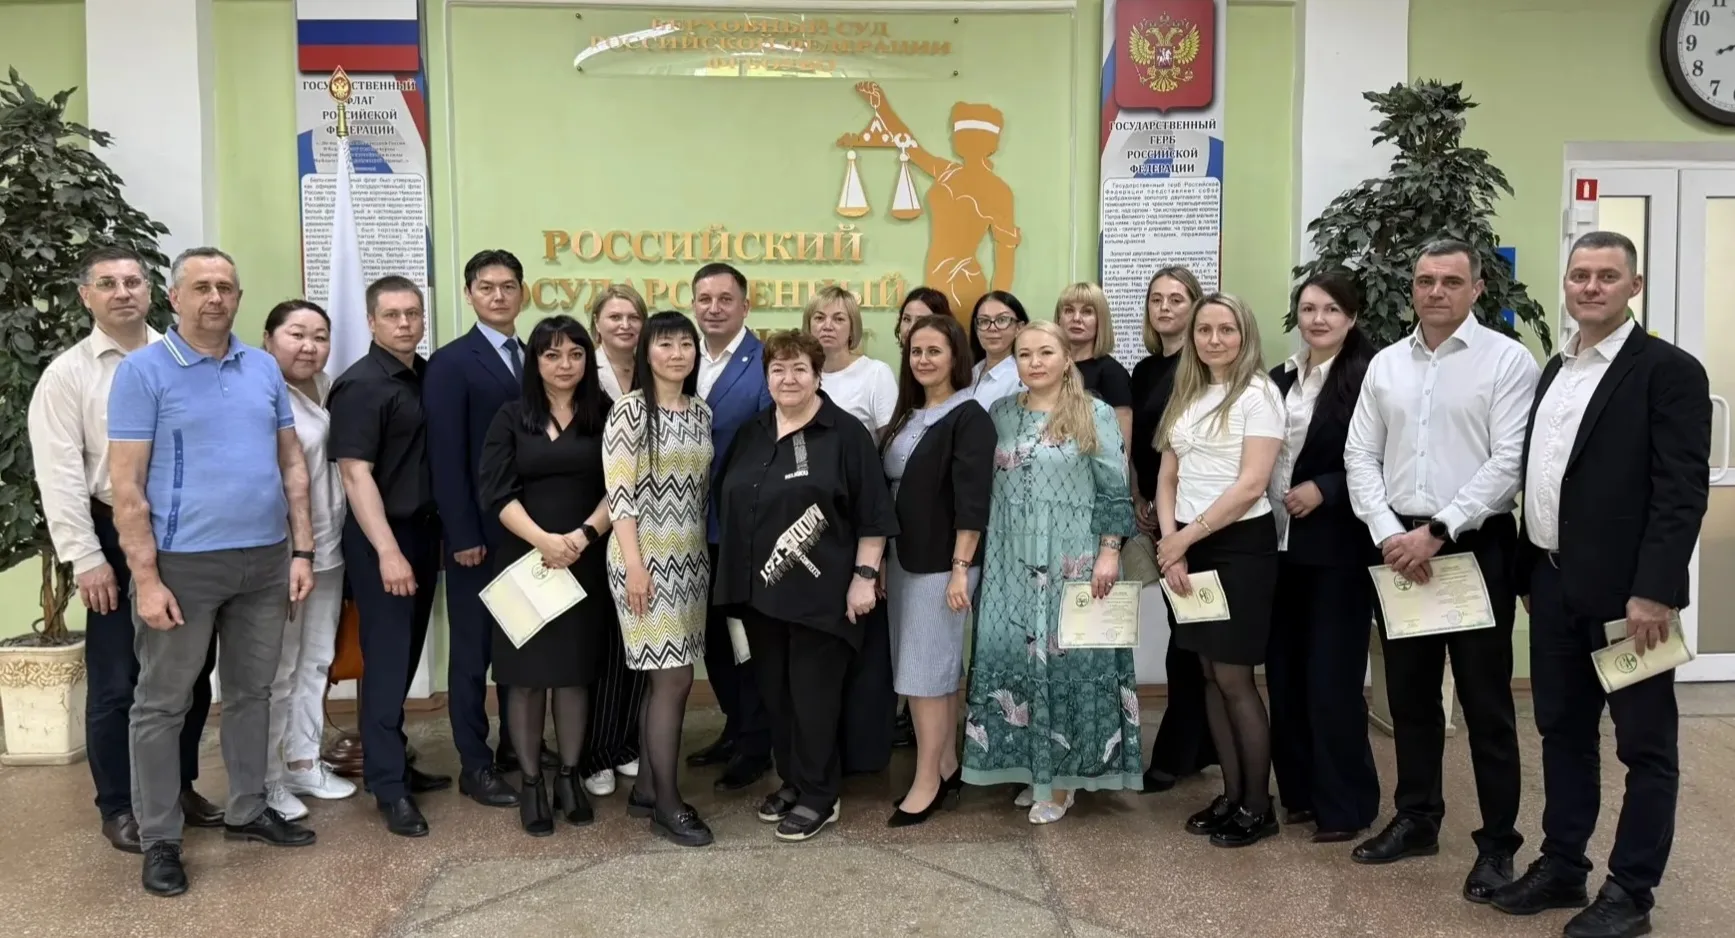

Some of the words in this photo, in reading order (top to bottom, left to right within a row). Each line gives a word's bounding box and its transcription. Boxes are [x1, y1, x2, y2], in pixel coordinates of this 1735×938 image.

[1692, 10, 1710, 26] 10
[836, 20, 888, 37] СУД
[1686, 34, 1697, 51] 9
[1692, 59, 1703, 76] 8
[303, 78, 417, 92] ГОСУСТВЕННЫЙ
[1710, 79, 1721, 96] 7
[322, 109, 398, 120] РОСИЙСКОЙ
[326, 125, 395, 136] ФЕРАЦИИ
[1109, 118, 1217, 131] ГОСУДАРСТВЕННЫЙ
[1150, 135, 1176, 145] ГЕРБ
[1127, 147, 1198, 159] РОССИЙСКОЙ
[1129, 163, 1195, 174] ФЕДЕРАЦИИ
[543, 224, 863, 262] РОССИЙСКИЙ
